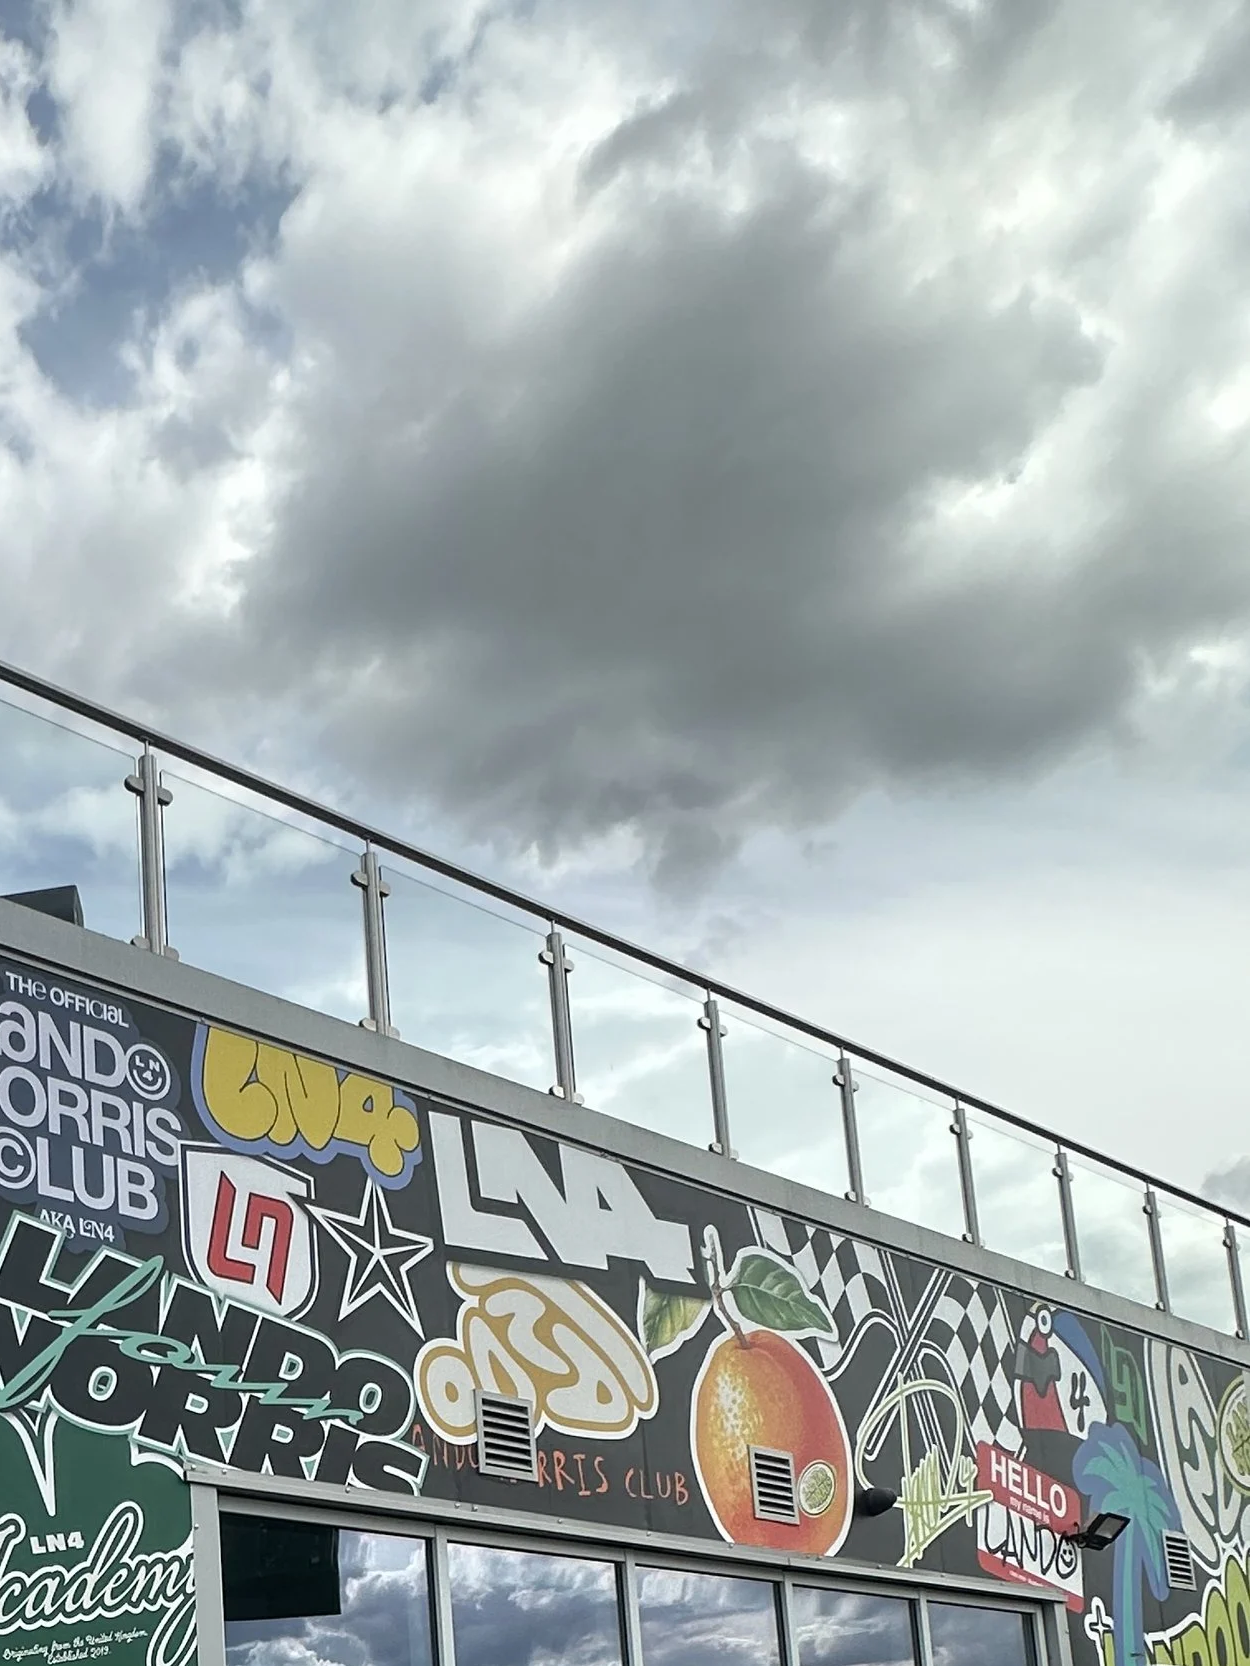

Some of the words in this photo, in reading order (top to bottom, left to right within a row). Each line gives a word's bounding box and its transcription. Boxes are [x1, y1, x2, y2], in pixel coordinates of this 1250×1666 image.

[199, 1023, 423, 1182] LN4
[78, 1217, 116, 1243] LN4
[624, 1467, 689, 1506] CLUB
[990, 1450, 1068, 1519] HELLO
[29, 1531, 85, 1555] LN4
[984, 1503, 1079, 1580] LANDO
